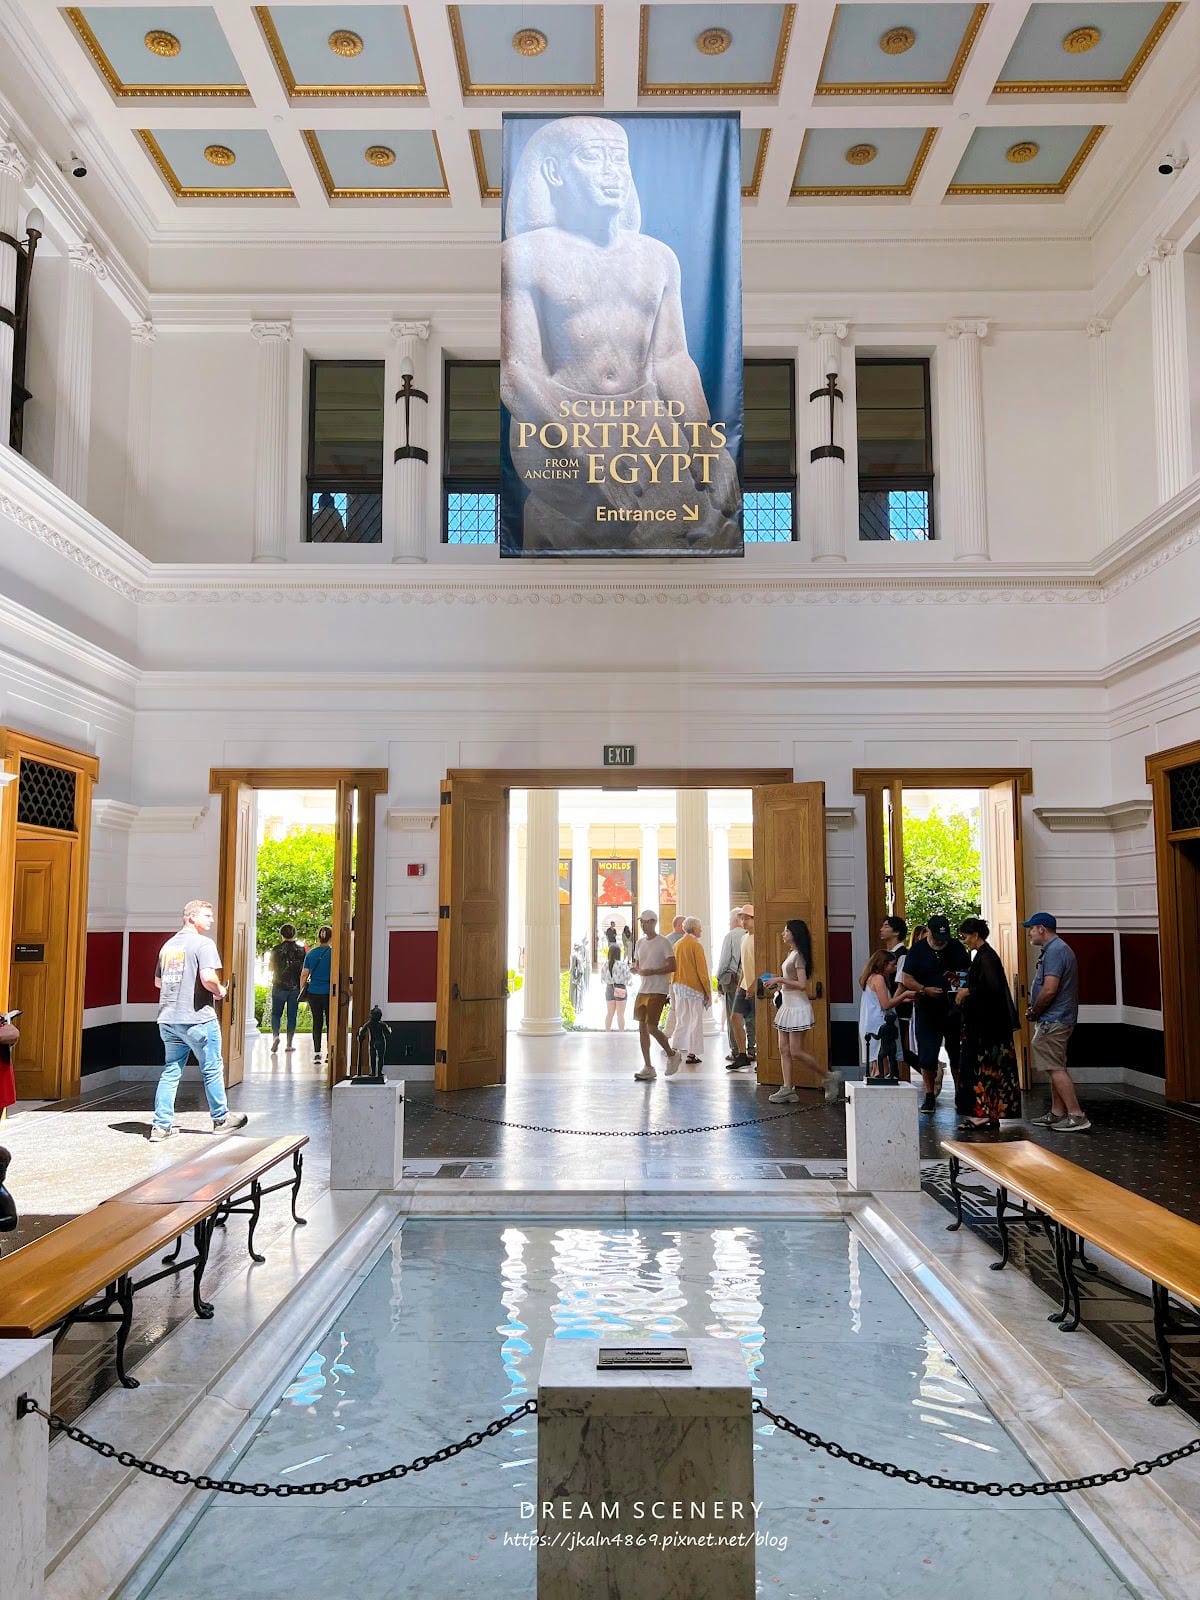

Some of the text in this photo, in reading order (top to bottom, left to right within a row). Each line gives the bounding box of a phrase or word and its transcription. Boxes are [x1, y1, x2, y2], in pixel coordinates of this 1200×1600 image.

[559, 400, 685, 418] SCULPTED
[517, 421, 727, 449] PORTRAITS
[545, 458, 579, 468] FROM
[586, 453, 720, 484] EGYPT
[525, 469, 580, 480] ANCIENT
[596, 506, 677, 521] Entrance
[608, 748, 631, 763] EXIT
[599, 862, 631, 870] WORLDS
